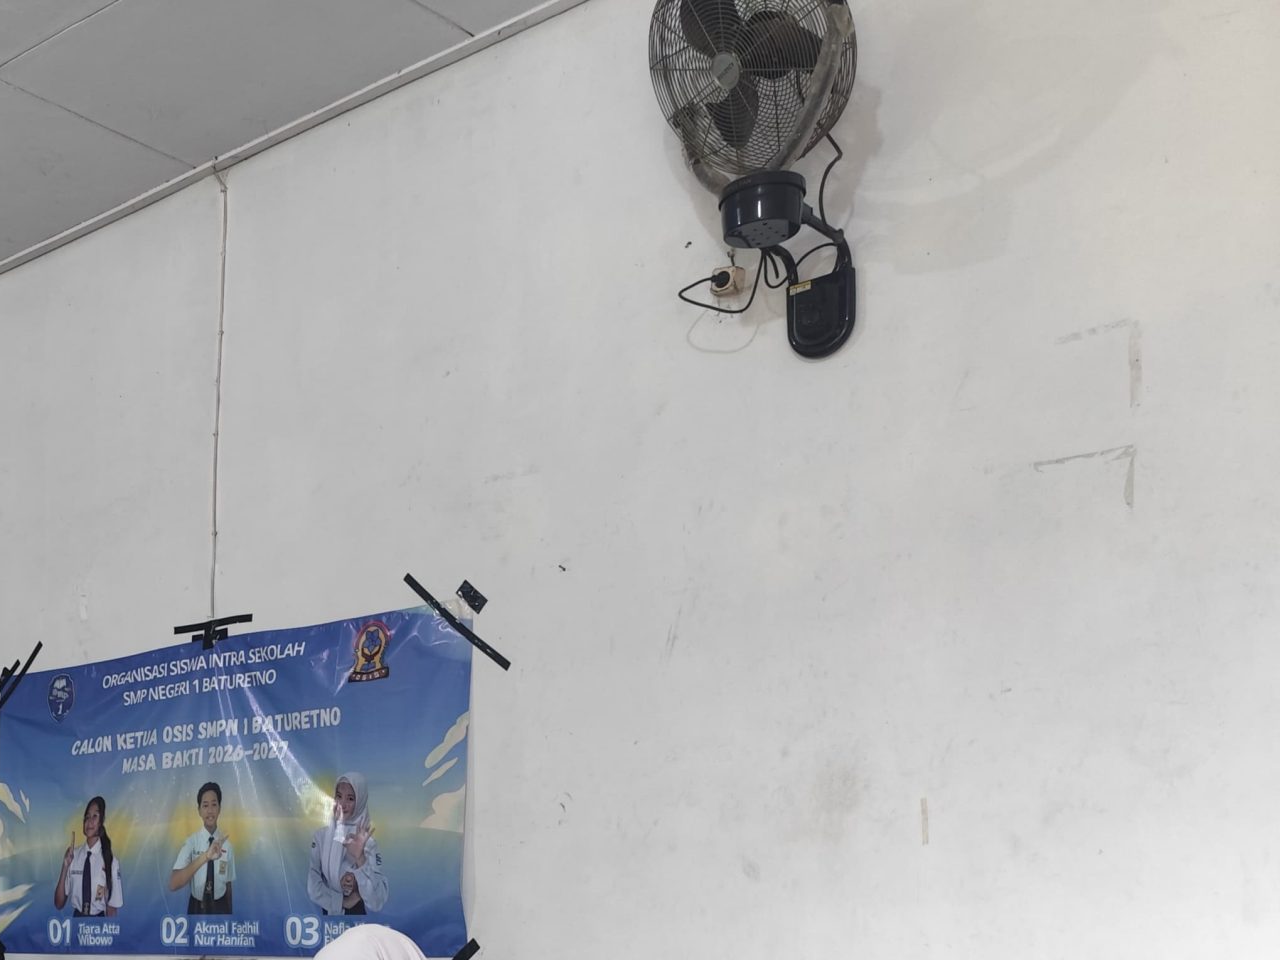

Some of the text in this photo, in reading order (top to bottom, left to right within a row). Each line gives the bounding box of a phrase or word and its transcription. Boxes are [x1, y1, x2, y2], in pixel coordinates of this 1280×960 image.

[102, 641, 306, 690] ORGANISASI SISWA INTRA SEKOLAH
[123, 669, 277, 706] SMP NEGERI 1 BATURETNO
[71, 735, 112, 756] CALON
[117, 728, 157, 751] KETUA
[163, 722, 194, 744] OSIS
[197, 718, 238, 739] SMPN
[252, 706, 342, 732] BATURETNO
[122, 755, 157, 774] MASA
[162, 748, 203, 769] BAKTI
[49, 917, 71, 944] 01
[78, 923, 101, 934] Tiara
[78, 934, 114, 946] Wibowo
[162, 916, 188, 944] 02
[194, 921, 259, 935] Akmal Fadhil
[194, 934, 256, 947] Nur Hanifan
[285, 916, 320, 946] 03
